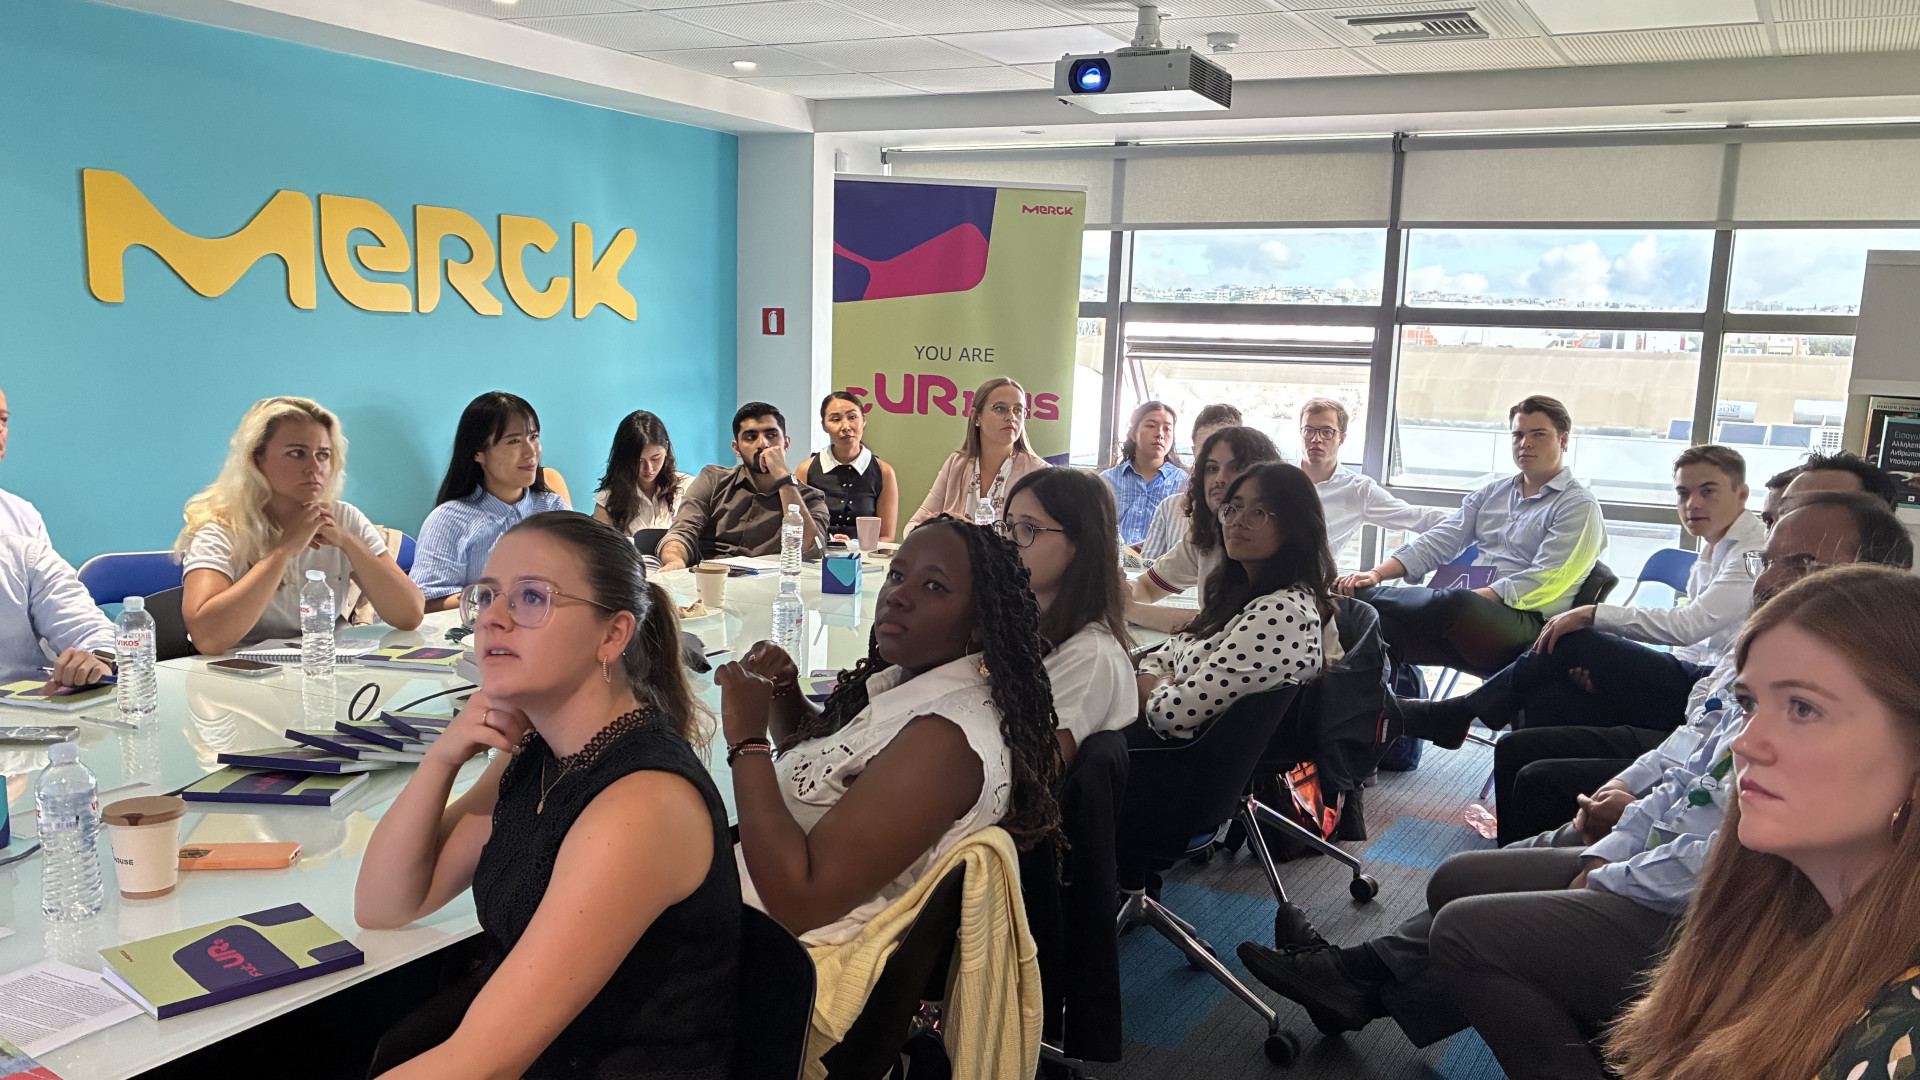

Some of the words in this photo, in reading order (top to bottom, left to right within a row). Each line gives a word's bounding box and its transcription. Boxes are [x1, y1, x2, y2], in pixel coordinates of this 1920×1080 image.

[1022, 204, 1074, 216] MERCK
[83, 167, 638, 322] MERCK
[914, 345, 952, 361] YOU
[958, 347, 995, 363] ARE
[116, 639, 140, 647] VIKOS
